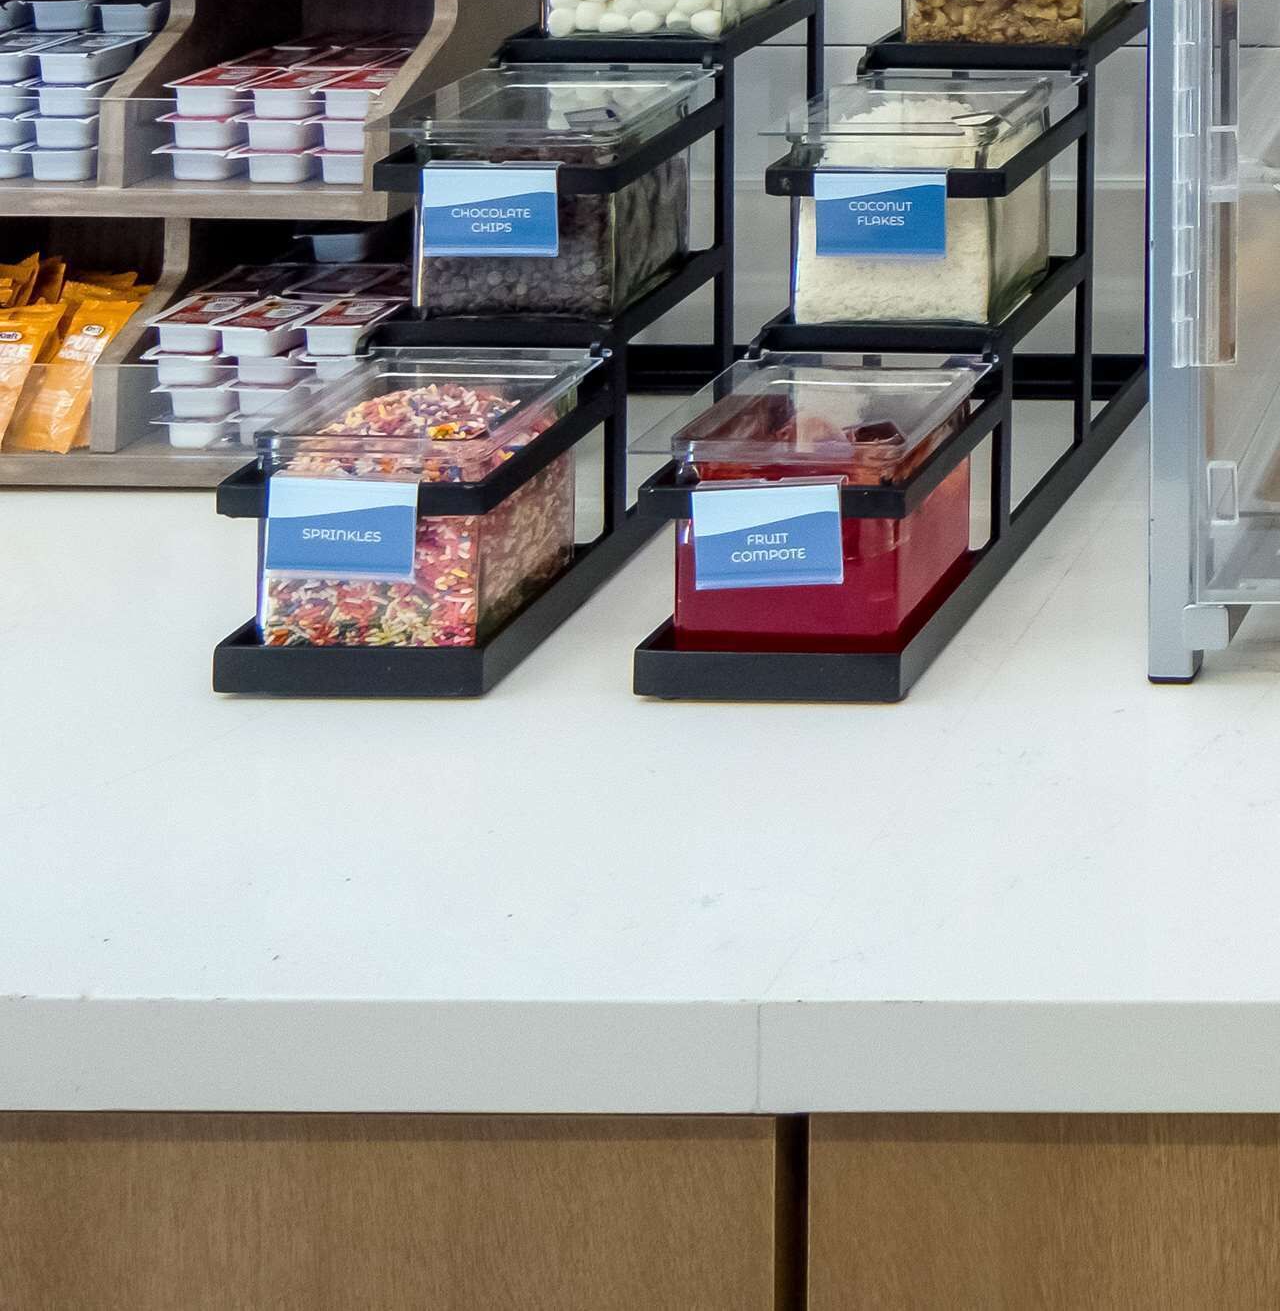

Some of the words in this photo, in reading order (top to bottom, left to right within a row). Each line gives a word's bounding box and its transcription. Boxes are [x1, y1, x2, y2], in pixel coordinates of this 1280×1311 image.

[848, 201, 913, 211] COCONUT
[451, 208, 532, 219] CHOCOLATE
[857, 216, 905, 226] FLAKES
[471, 222, 513, 233] CHIPS
[302, 528, 382, 543] SPRINKLES
[747, 532, 789, 546] FRUIT
[731, 547, 807, 563] COMPOTE
